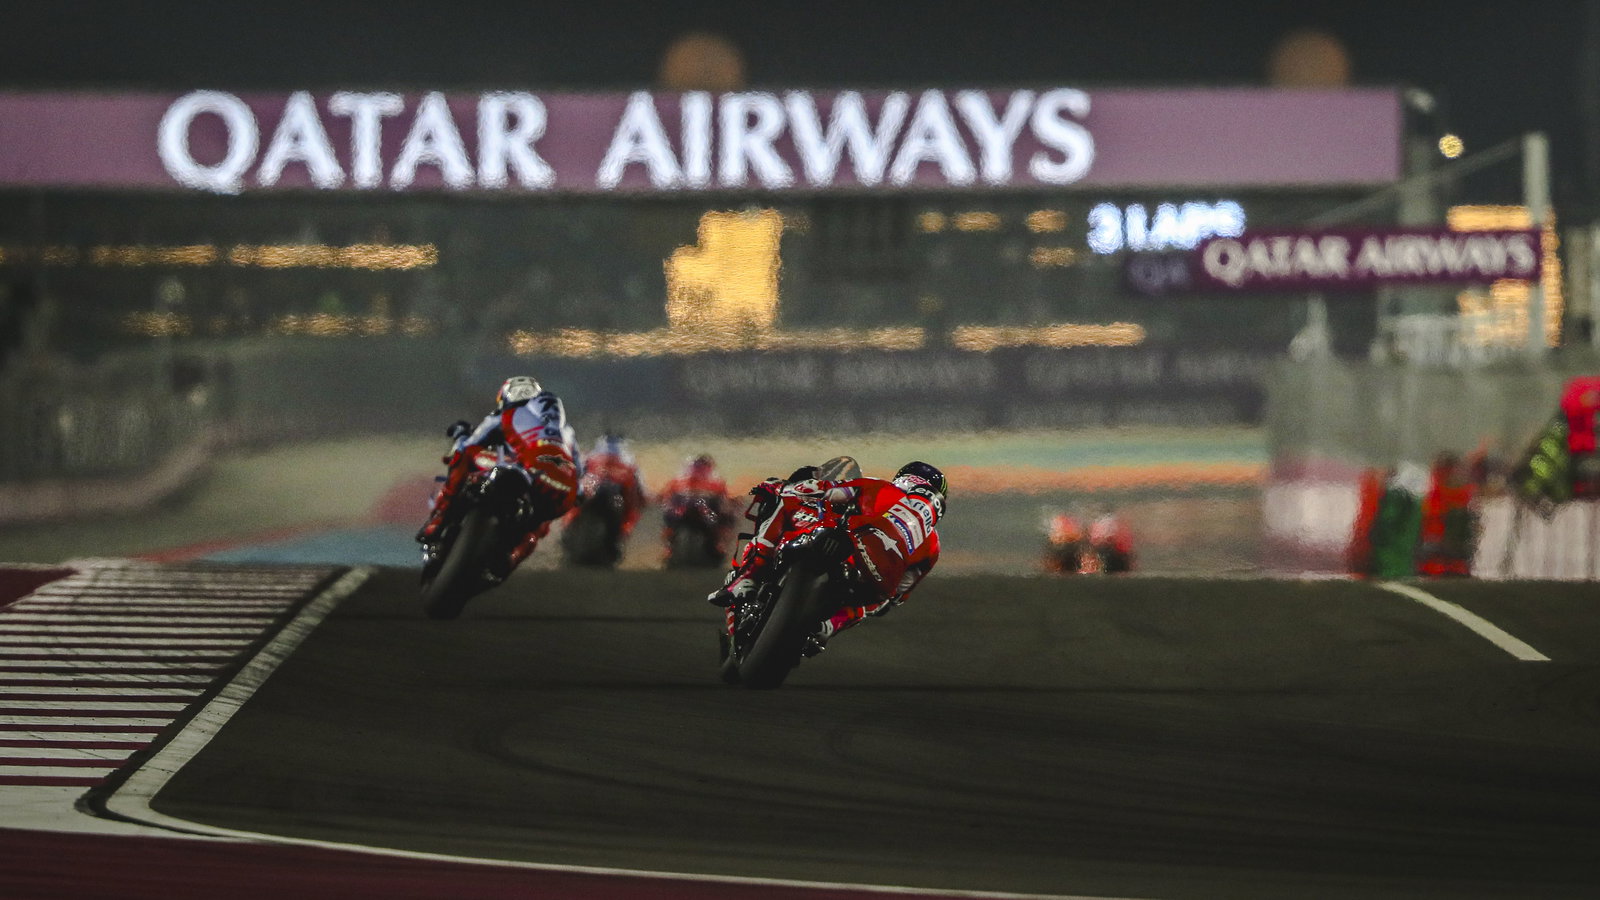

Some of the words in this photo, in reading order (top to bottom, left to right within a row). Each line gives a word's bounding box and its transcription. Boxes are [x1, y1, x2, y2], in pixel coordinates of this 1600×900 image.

[158, 89, 556, 193] QATAR
[596, 88, 1095, 190] AIRWAYS
[1087, 202, 1123, 254] 3
[1203, 235, 1350, 287] QATAR
[1355, 233, 1536, 276] AIRWAYS
